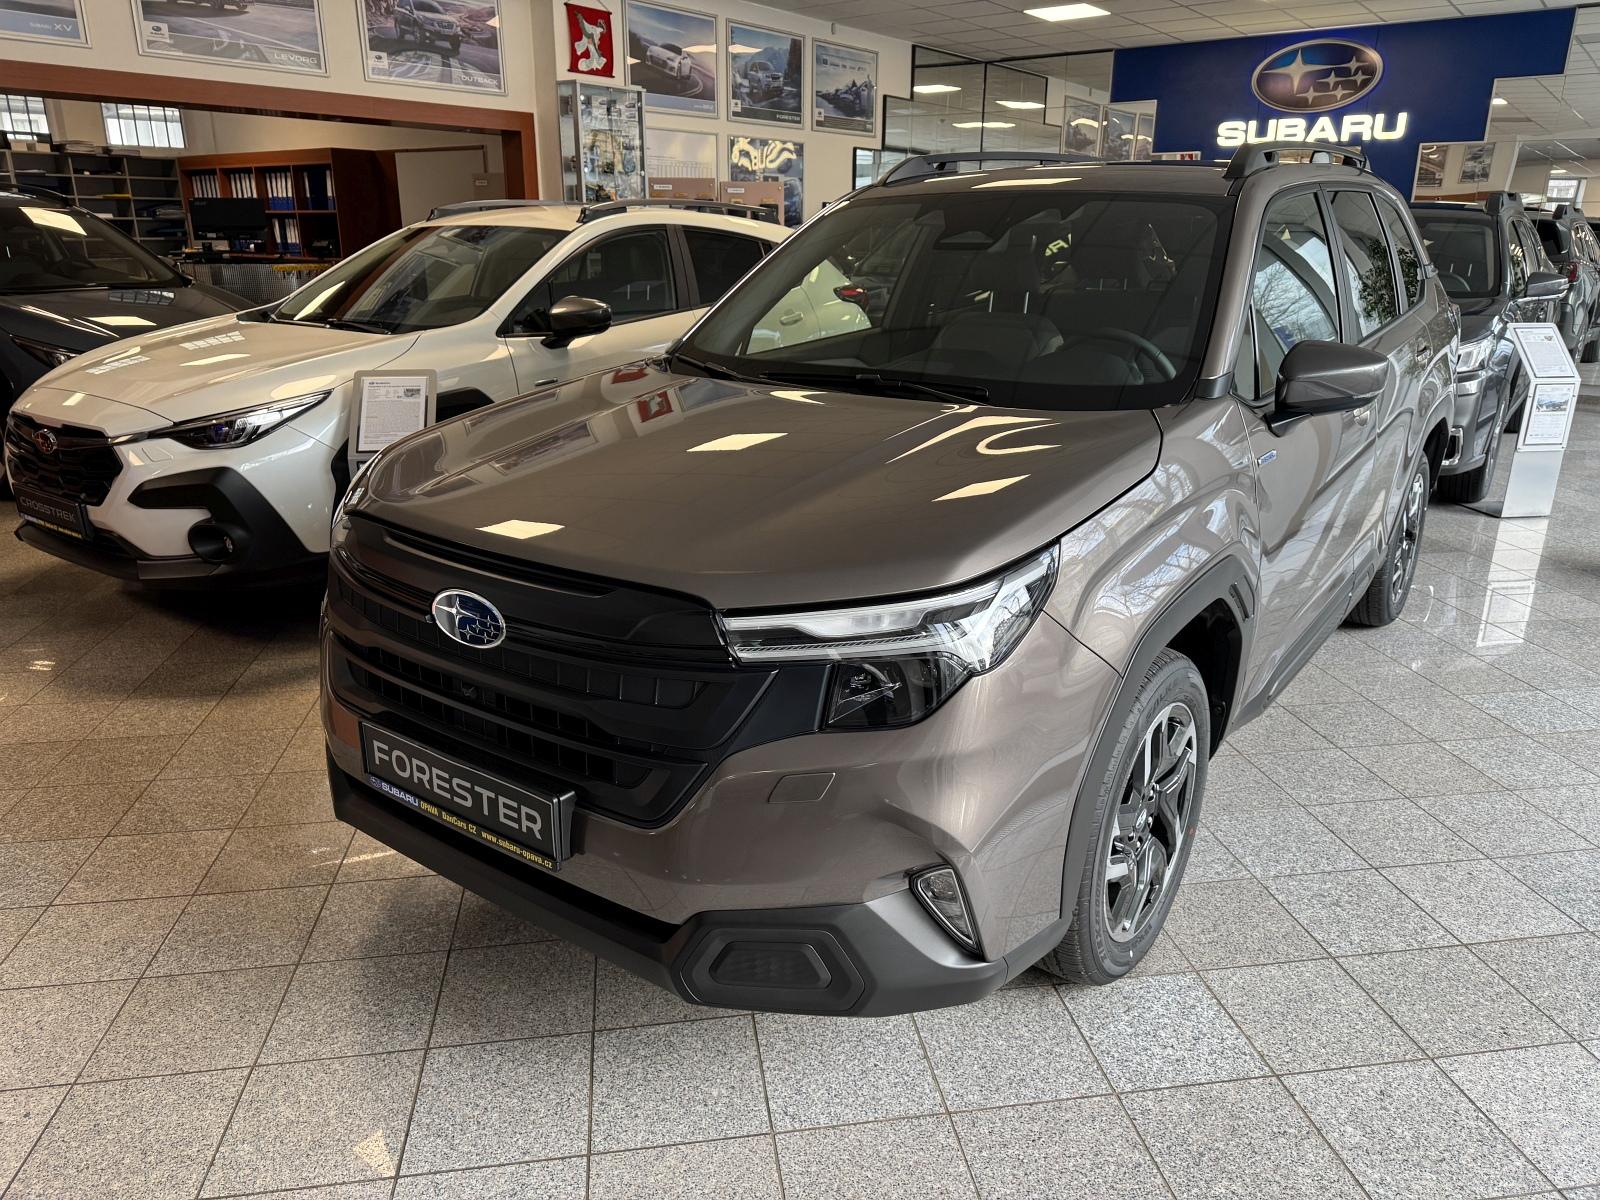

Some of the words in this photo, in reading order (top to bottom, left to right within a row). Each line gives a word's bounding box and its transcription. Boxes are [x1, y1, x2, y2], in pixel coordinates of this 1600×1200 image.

[54, 23, 73, 32] XV
[273, 51, 318, 65] LEVORG
[461, 74, 499, 86] OUTBACK
[1216, 112, 1408, 147] SUBARU
[19, 496, 76, 522] CROSSTREK
[372, 739, 542, 841] FORESTER
[381, 782, 419, 807] SUBARU
[420, 801, 439, 817] OPAVA
[441, 811, 467, 831] DanCars
[468, 823, 477, 834] CZ
[481, 831, 553, 869] www.subaru-opava.cz
